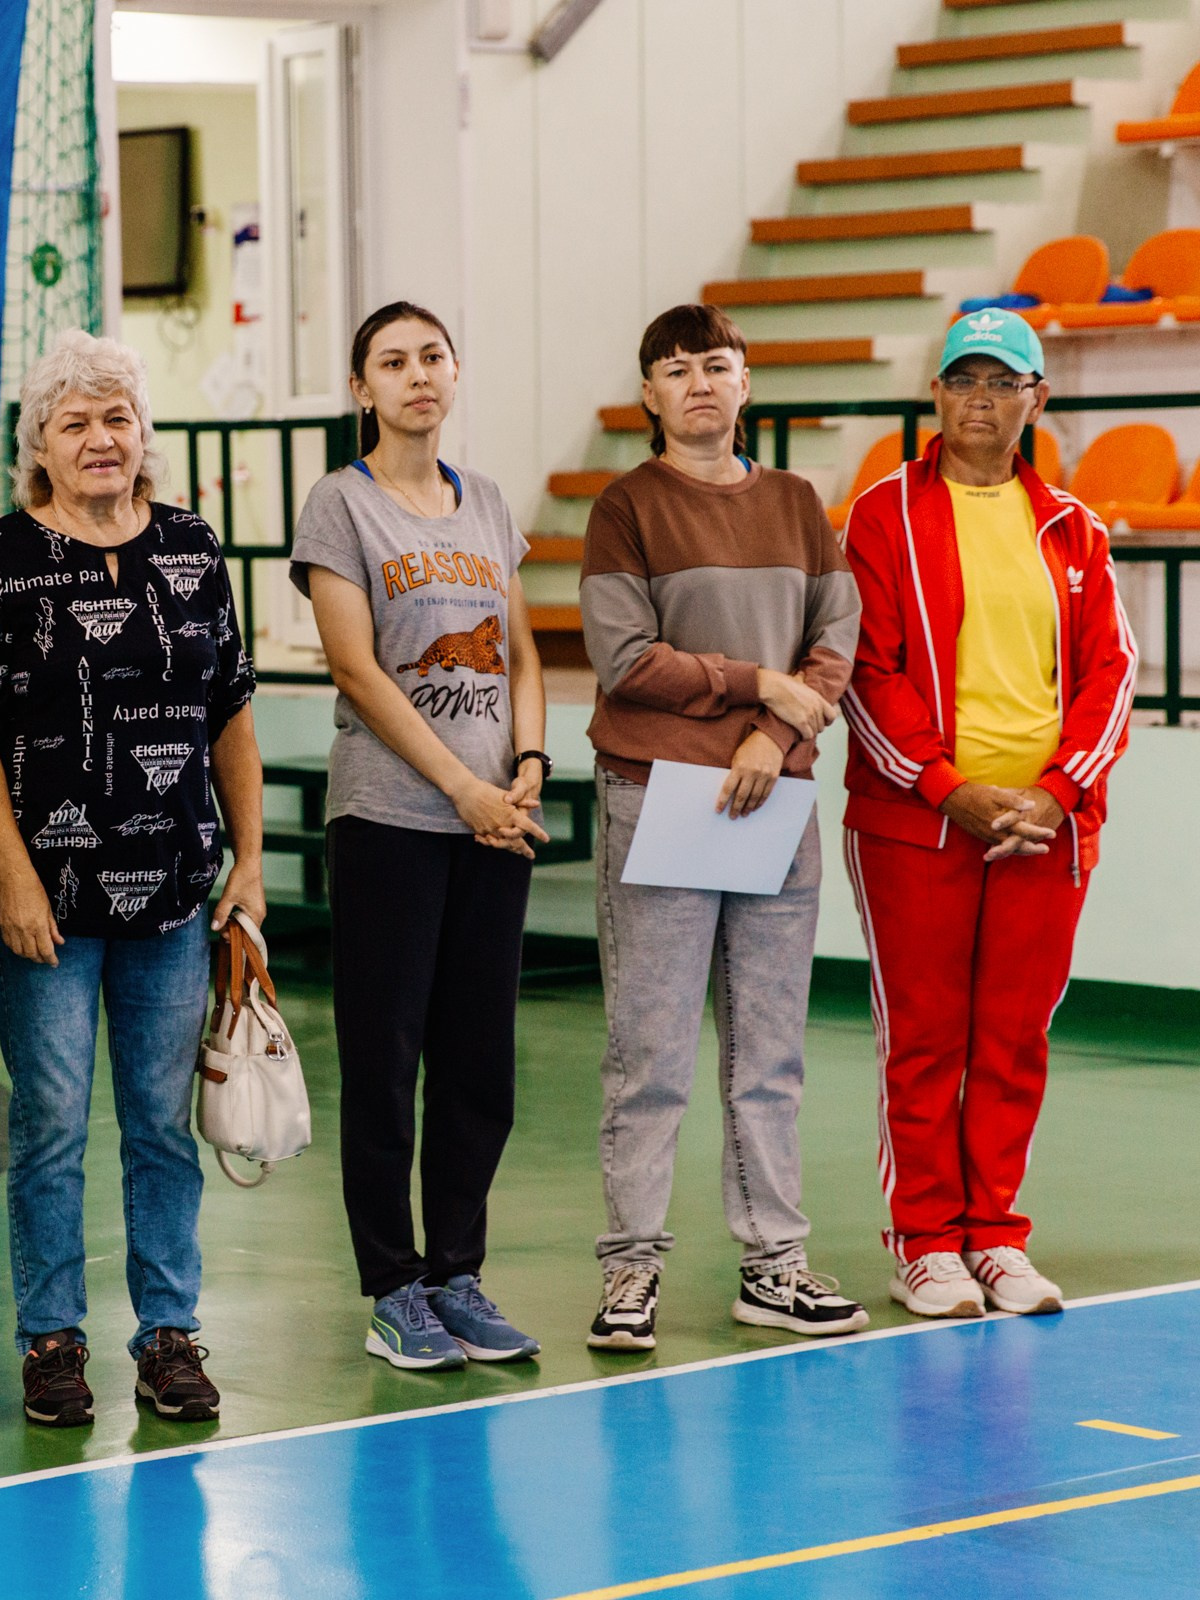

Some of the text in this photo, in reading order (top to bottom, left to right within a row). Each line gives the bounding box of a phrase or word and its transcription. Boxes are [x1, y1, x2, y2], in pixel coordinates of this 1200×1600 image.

[963, 333, 1003, 343] adidas
[152, 552, 209, 566] EIGHTIES
[166, 574, 201, 596] Tour
[381, 551, 507, 600] REASONS
[71, 598, 133, 612] EIGHTIES
[82, 620, 123, 641] Tour
[146, 581, 174, 682] AUTHENTIC
[410, 680, 500, 723] POWER
[77, 656, 94, 773] AUTHENTIC
[112, 703, 160, 723] party
[135, 743, 190, 757] EIGHTIES
[104, 732, 115, 797] ultimate party
[145, 766, 180, 792] Tour
[48, 803, 90, 827] Tour
[35, 836, 97, 849] EIGHTIES
[100, 869, 164, 883] EIGHTIES
[108, 893, 150, 916] Tour
